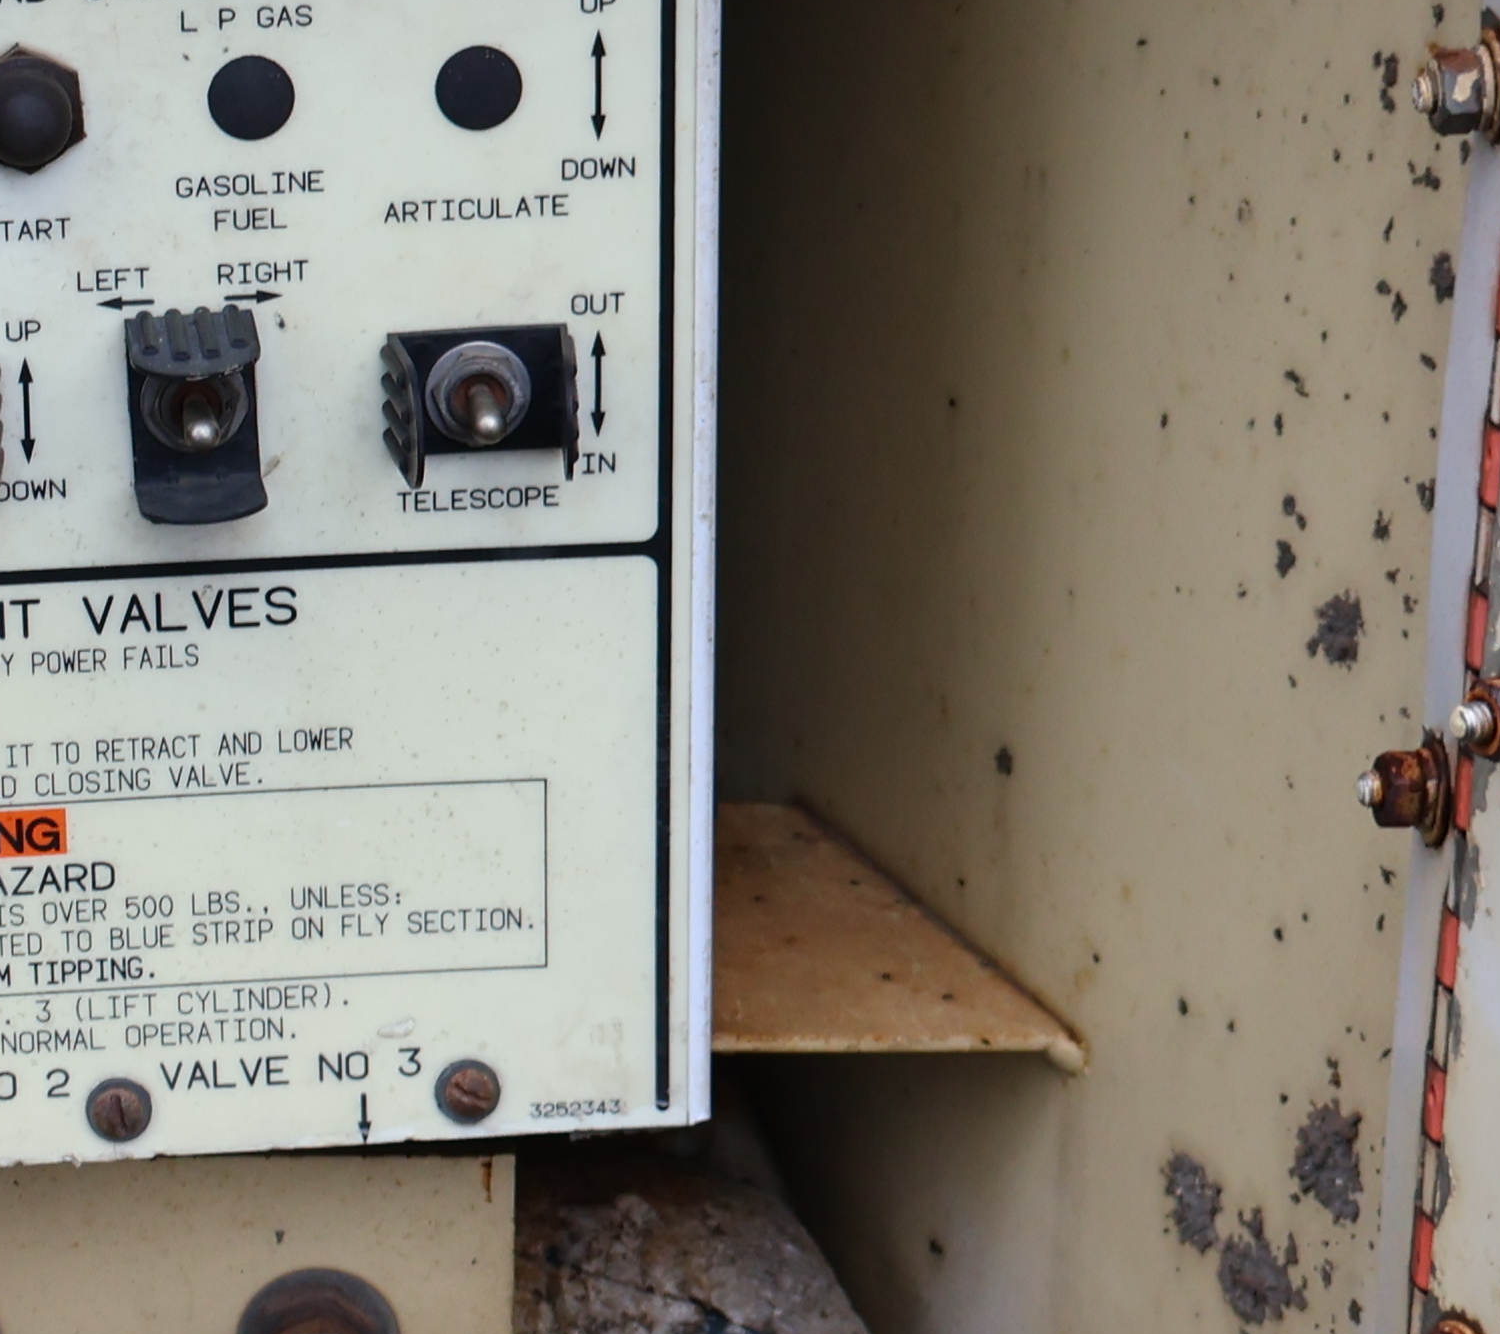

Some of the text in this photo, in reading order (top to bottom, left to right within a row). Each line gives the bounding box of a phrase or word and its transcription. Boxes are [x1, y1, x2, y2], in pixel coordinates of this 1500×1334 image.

[181, 5, 312, 32] L P GAS
[562, 157, 635, 181] DOWN
[176, 170, 324, 198] GASOLINE
[214, 208, 287, 231] FUEL
[384, 194, 568, 223] ARTICULATE
[77, 260, 308, 292] LEFT RIGHT
[571, 292, 625, 315] OUT
[6, 320, 41, 342] UP
[582, 453, 615, 474] IN
[397, 485, 559, 512] TELESCOPE
[82, 585, 297, 635] VALVES
[32, 649, 106, 674] POWER
[124, 644, 198, 670] FAILS
[28, 956, 154, 985] TIPPING.
[160, 1047, 421, 1090] VALVE NO 3
[46, 1068, 70, 1098] 2
[529, 1099, 621, 1119] 3252343
